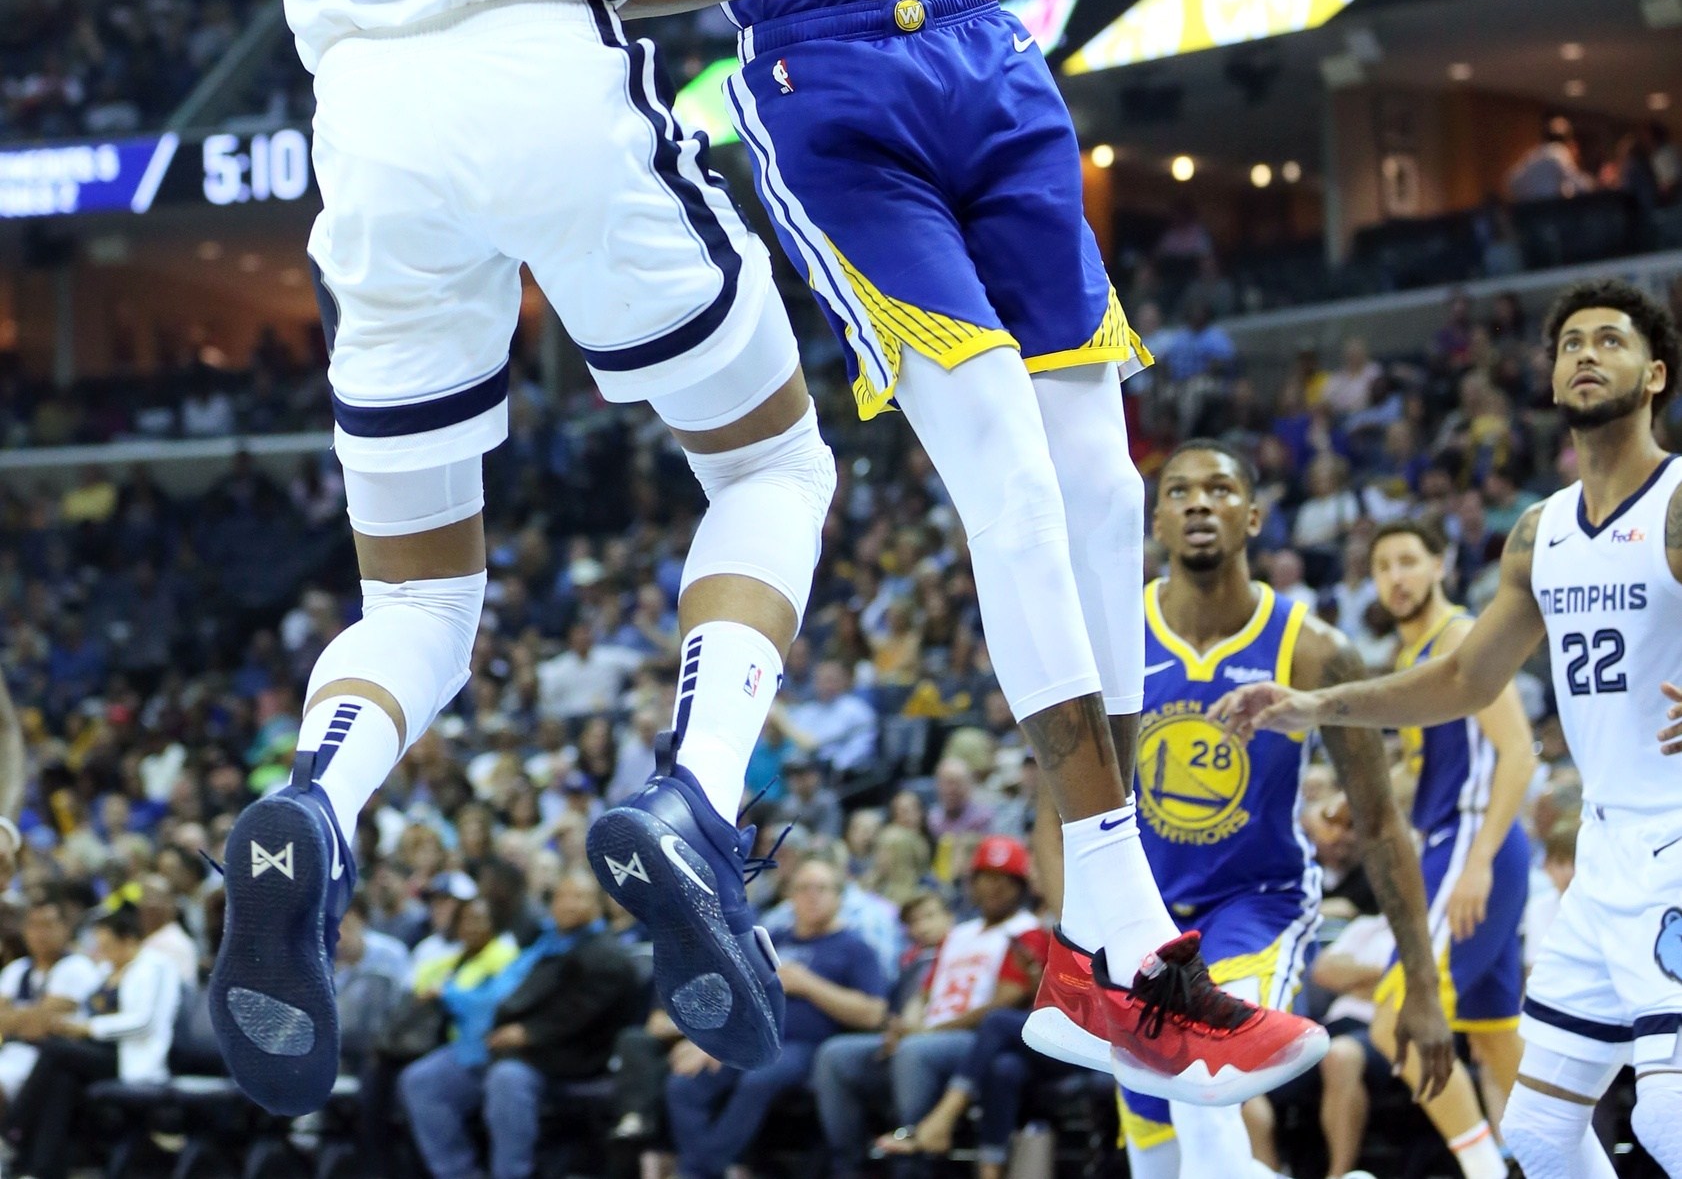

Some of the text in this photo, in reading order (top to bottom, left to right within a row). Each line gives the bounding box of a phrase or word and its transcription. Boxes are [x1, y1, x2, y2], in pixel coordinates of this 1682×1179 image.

[897, 4, 922, 26] W
[203, 129, 309, 205] 5:10
[1611, 528, 1646, 543] FedEx
[1540, 582, 1648, 616] MEMPHIS
[1562, 628, 1628, 697] 22
[1139, 699, 1203, 731] OLDEN
[1188, 740, 1233, 771] 28
[1138, 795, 1250, 846] WARRIORS
